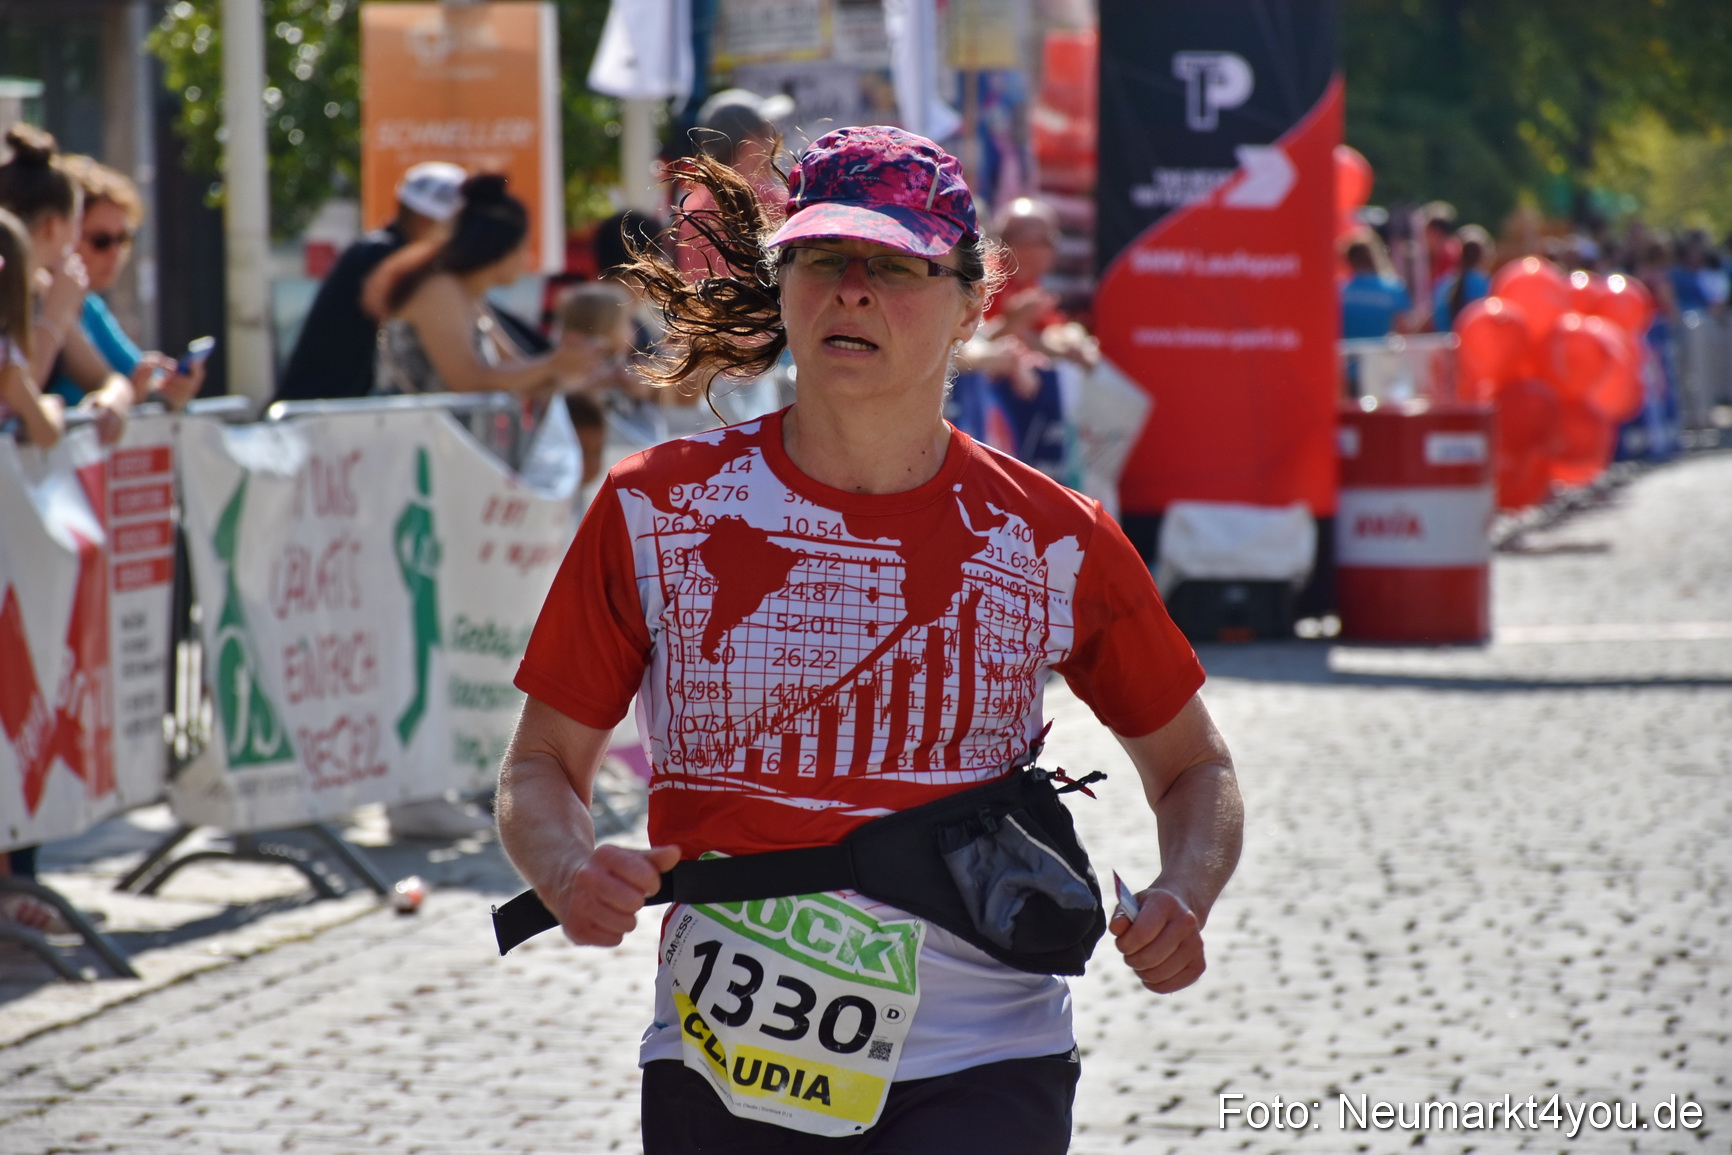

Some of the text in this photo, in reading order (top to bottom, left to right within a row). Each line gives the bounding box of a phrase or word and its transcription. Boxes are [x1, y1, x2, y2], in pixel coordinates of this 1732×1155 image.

[783, 515, 844, 540] 10.54
[984, 542, 1045, 579] 91.62%
[775, 612, 839, 635] 52.01
[772, 647, 837, 669] 26.22
[689, 939, 877, 1054] 1330
[886, 1007, 900, 1021] D
[683, 1012, 832, 1107] CLUDIA
